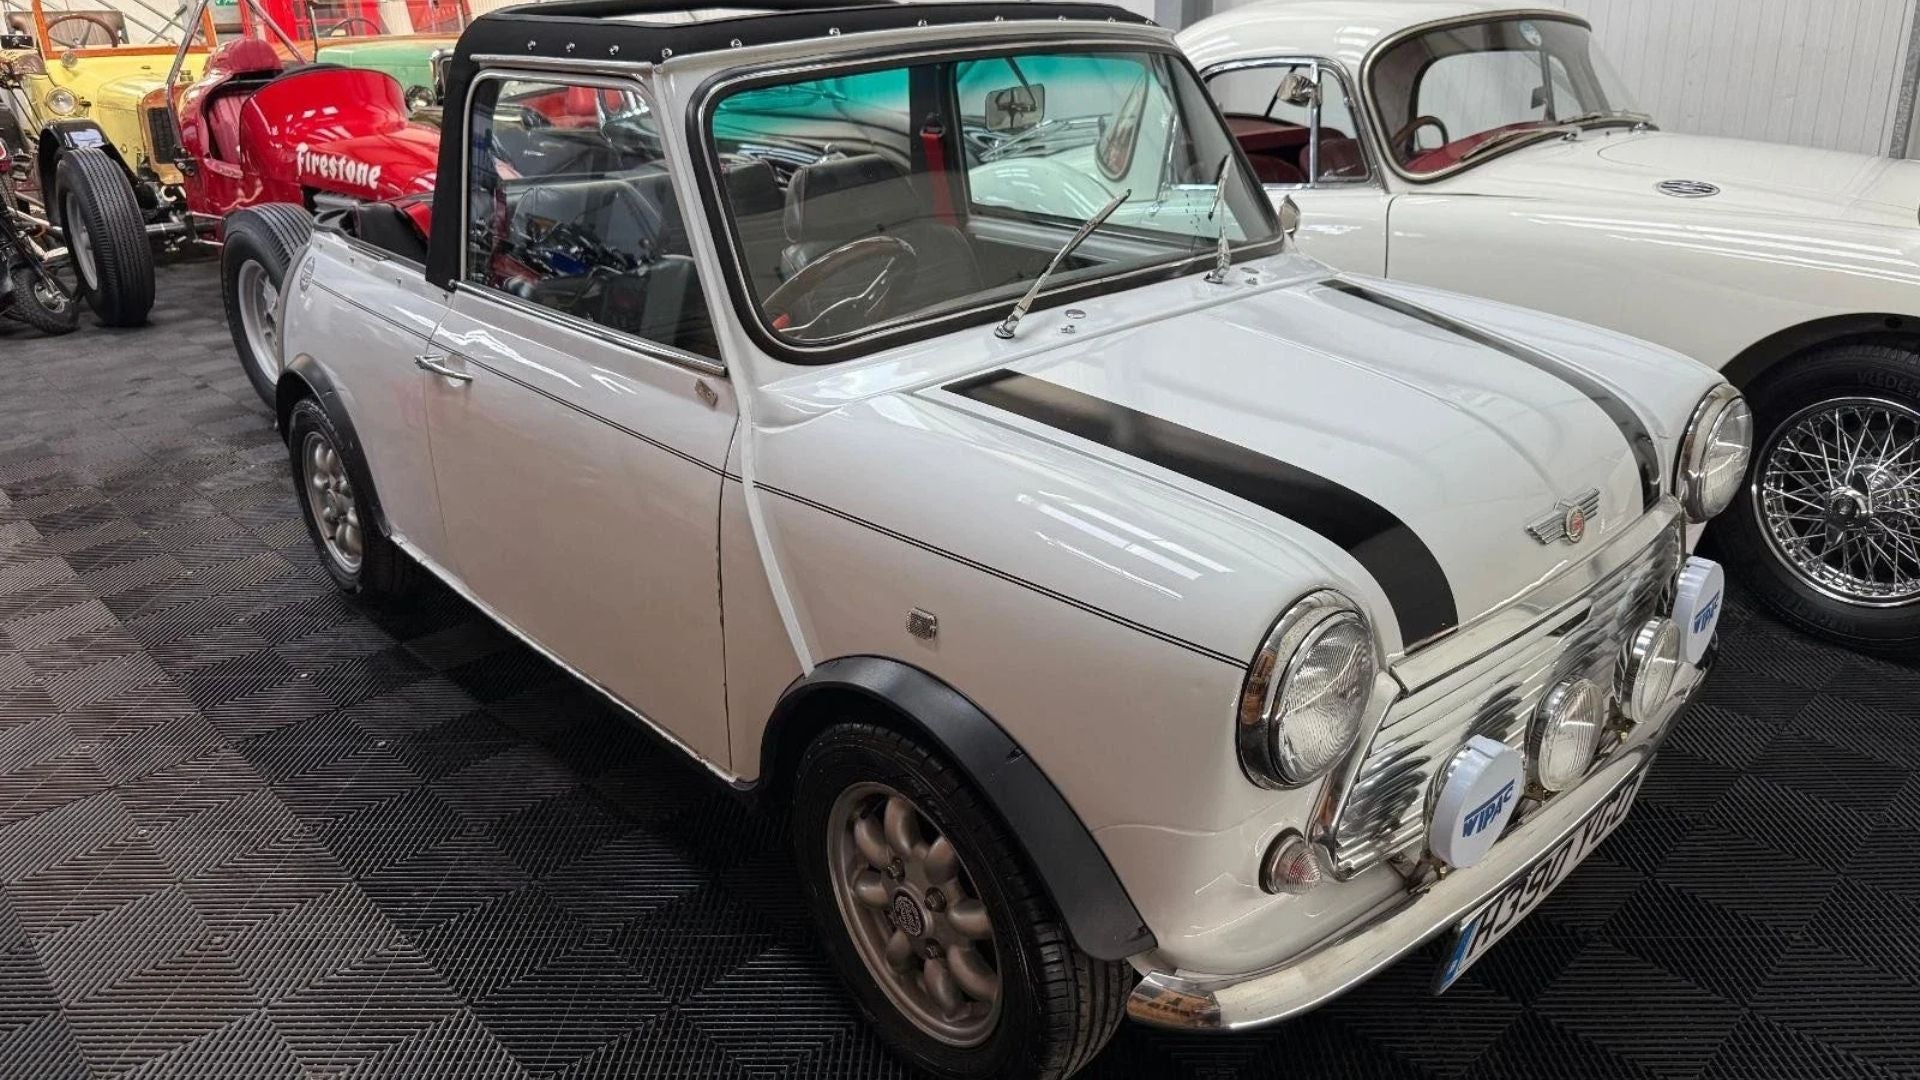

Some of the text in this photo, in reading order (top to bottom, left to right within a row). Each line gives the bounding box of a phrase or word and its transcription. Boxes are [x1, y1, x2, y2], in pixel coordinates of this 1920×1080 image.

[297, 143, 382, 189] Firestone
[1462, 783, 1514, 838] WIPAC
[1467, 839, 1575, 958] H390
